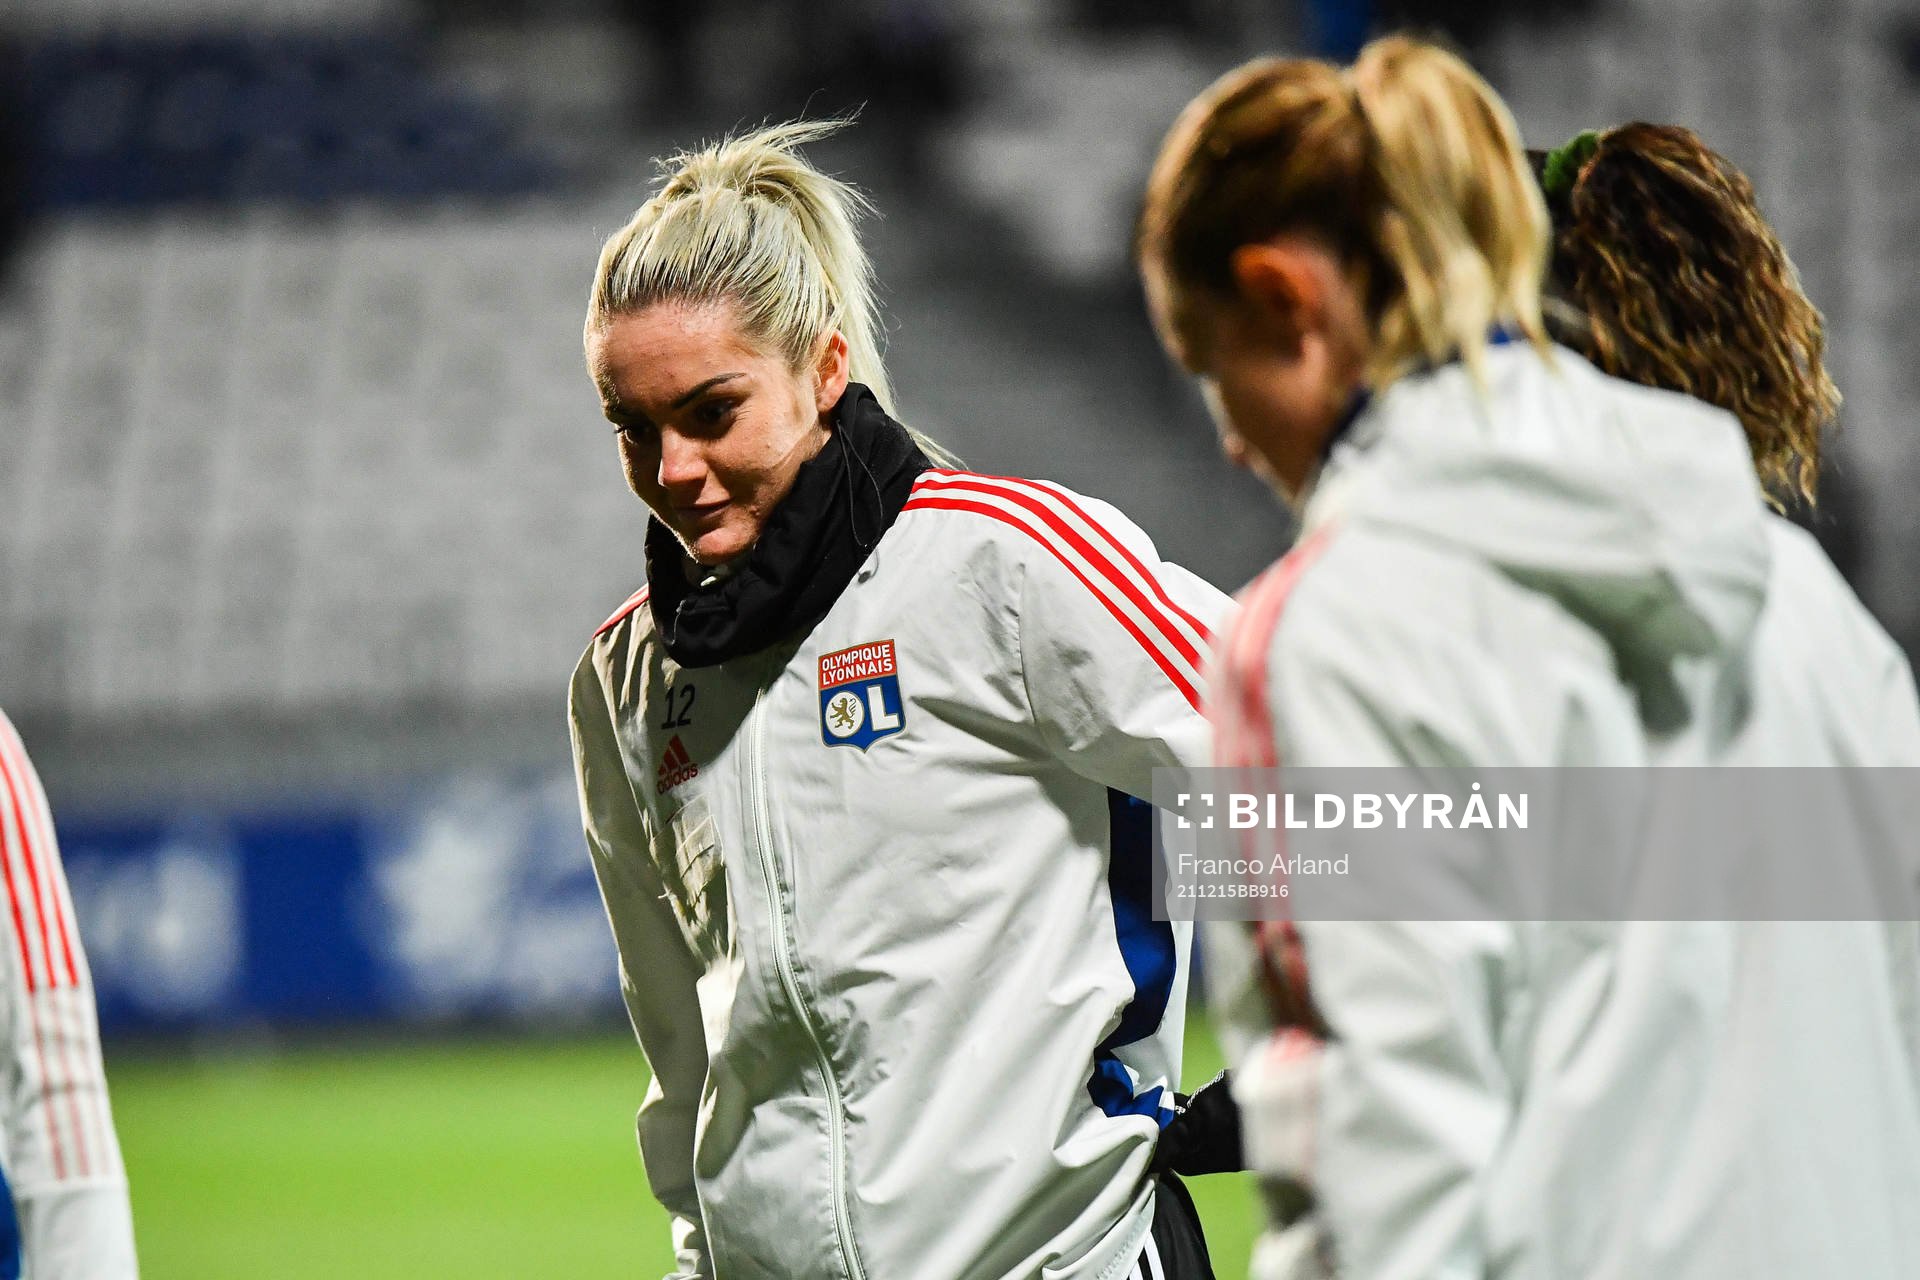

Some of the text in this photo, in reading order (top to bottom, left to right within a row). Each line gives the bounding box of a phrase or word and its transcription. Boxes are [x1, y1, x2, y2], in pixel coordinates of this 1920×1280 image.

[822, 644, 891, 671] OLYMPIQUE
[822, 658, 893, 686] LYONNAIS
[661, 684, 695, 729] 12
[656, 761, 699, 795] adidas
